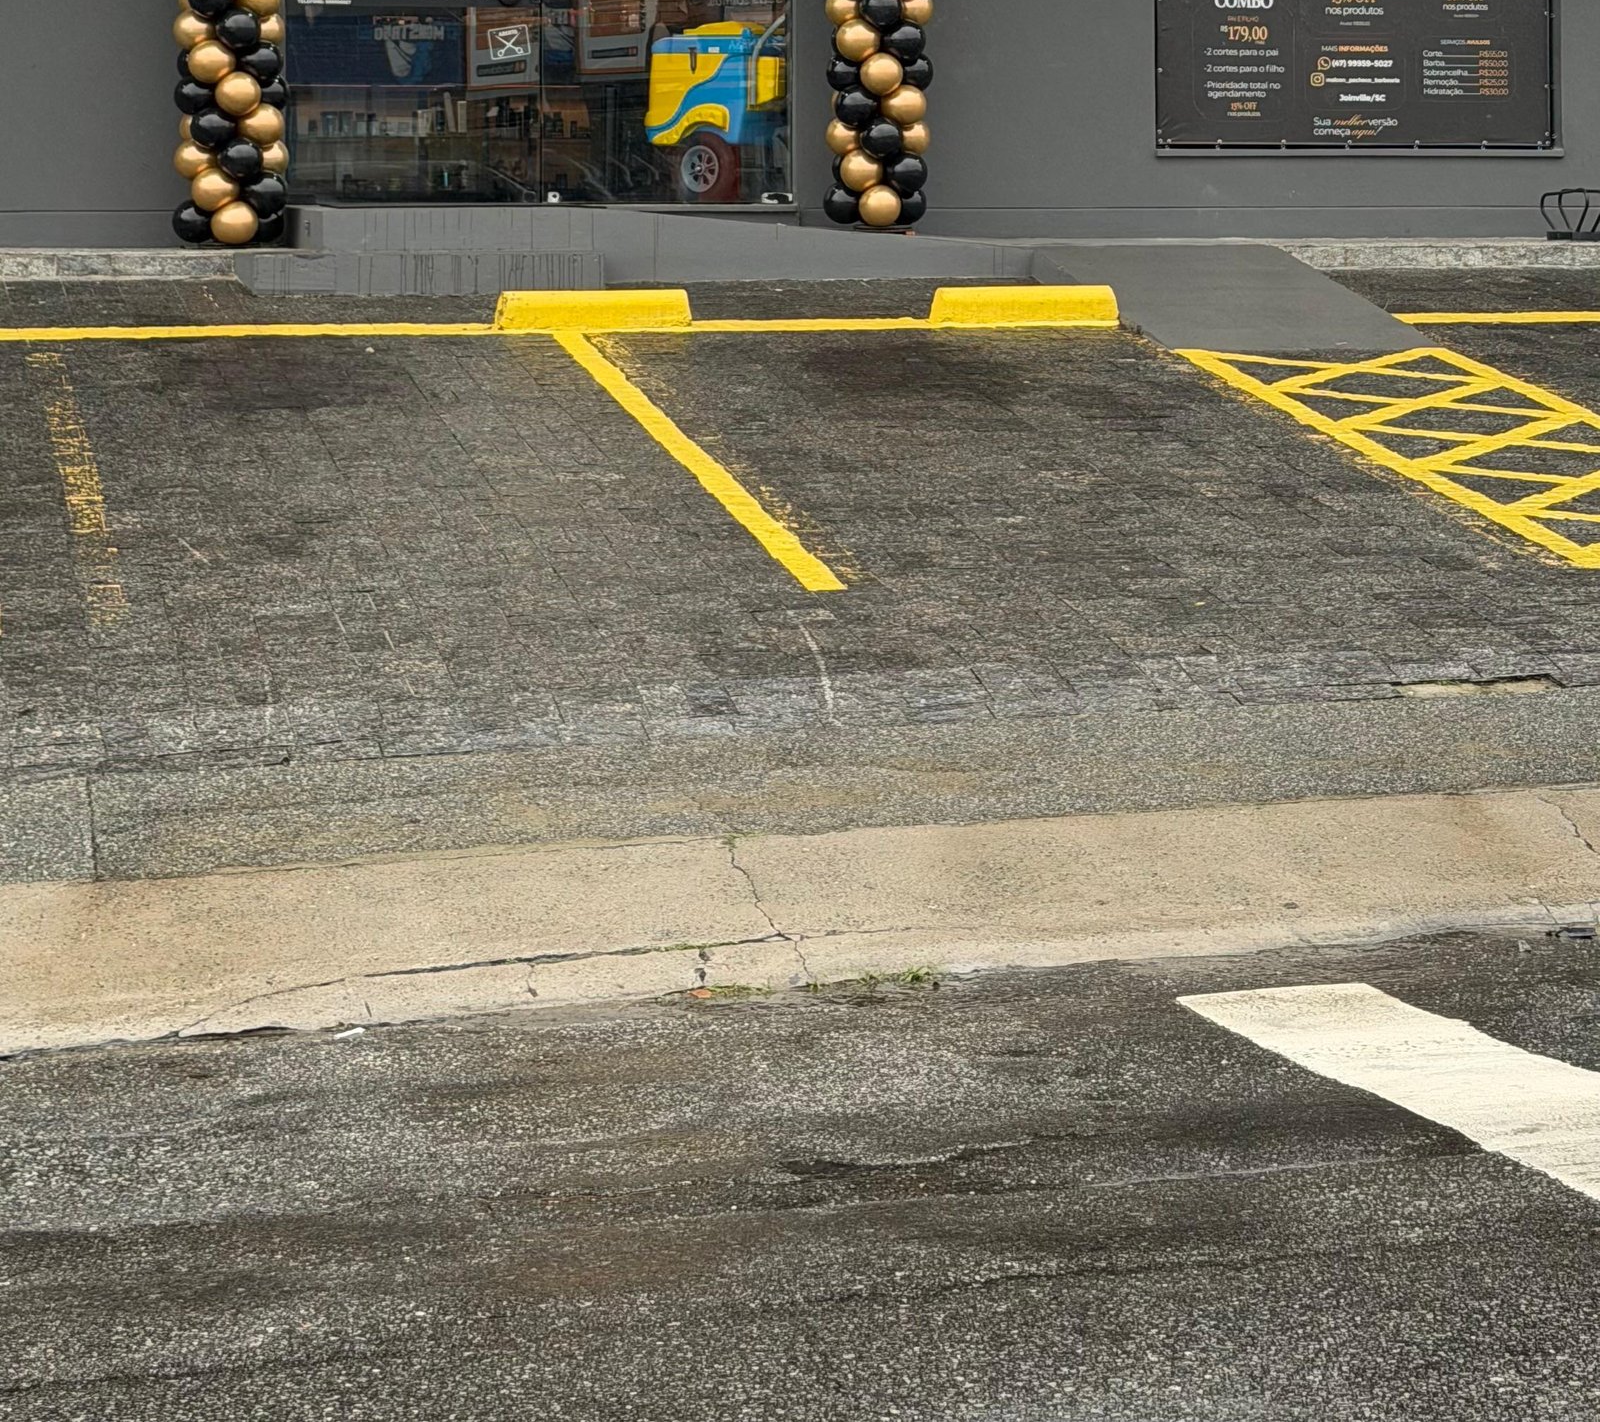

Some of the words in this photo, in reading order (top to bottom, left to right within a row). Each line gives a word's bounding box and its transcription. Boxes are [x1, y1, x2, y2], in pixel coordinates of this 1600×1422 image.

[1325, 6, 1342, 15] nos
[1343, 6, 1384, 16] produtos
[1456, 3, 1488, 11] produtos
[1228, 26, 1268, 42] 179,00
[1240, 49, 1257, 57] para
[1266, 48, 1279, 57] pai
[1240, 66, 1257, 74] para
[1266, 65, 1285, 73] filho
[1249, 81, 1268, 89] total
[1207, 90, 1266, 99] agendamento
[1313, 117, 1332, 126] Sua
[1367, 117, 1398, 126] versão
[1313, 128, 1351, 138] começa
